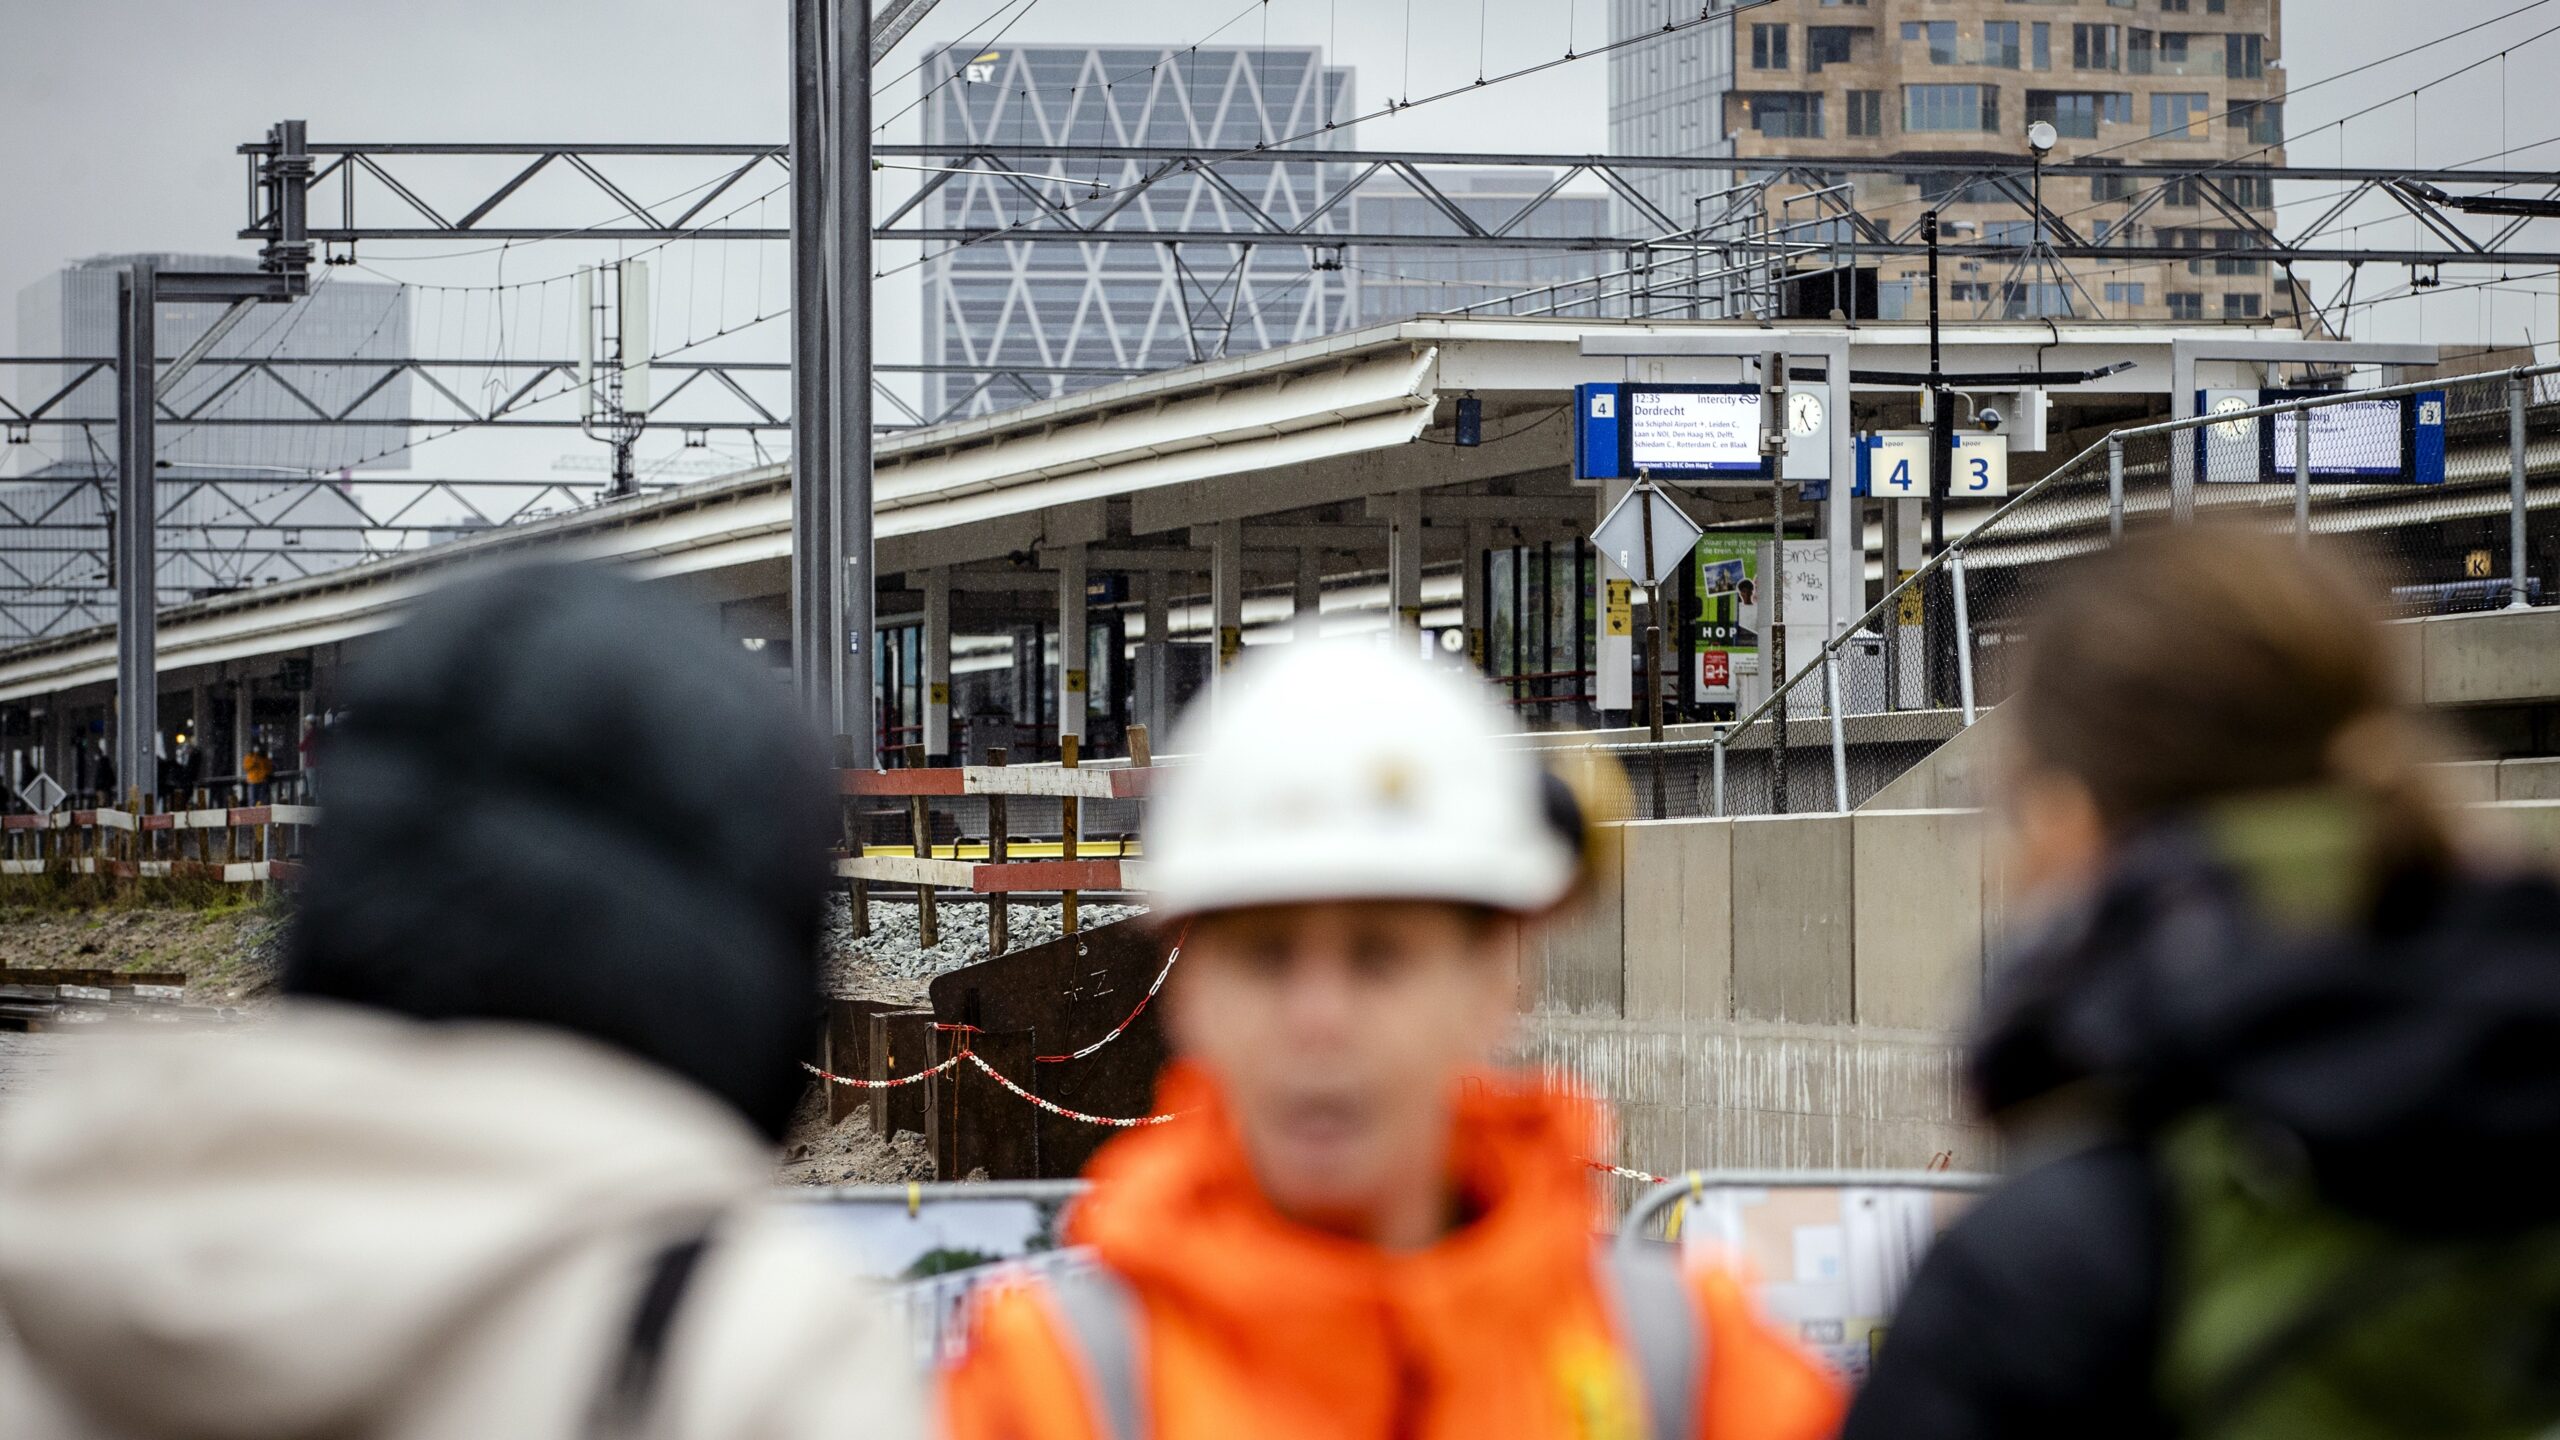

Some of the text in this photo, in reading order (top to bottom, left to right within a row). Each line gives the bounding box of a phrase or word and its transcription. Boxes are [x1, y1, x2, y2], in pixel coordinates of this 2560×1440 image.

[967, 64, 995, 82] EY
[1634, 394, 1661, 404] 12:35
[1697, 394, 1737, 407] Intercity
[1597, 403, 1607, 415] 4
[1634, 405, 1685, 416] Dordrecht
[2426, 410, 2435, 422] 3
[1646, 420, 1673, 428] Schiphol
[1675, 421, 1697, 429] Airport
[1687, 431, 1704, 439] Haag
[1889, 459, 1912, 491] 4
[1969, 458, 1989, 491] 3
[2474, 560, 2484, 575] K
